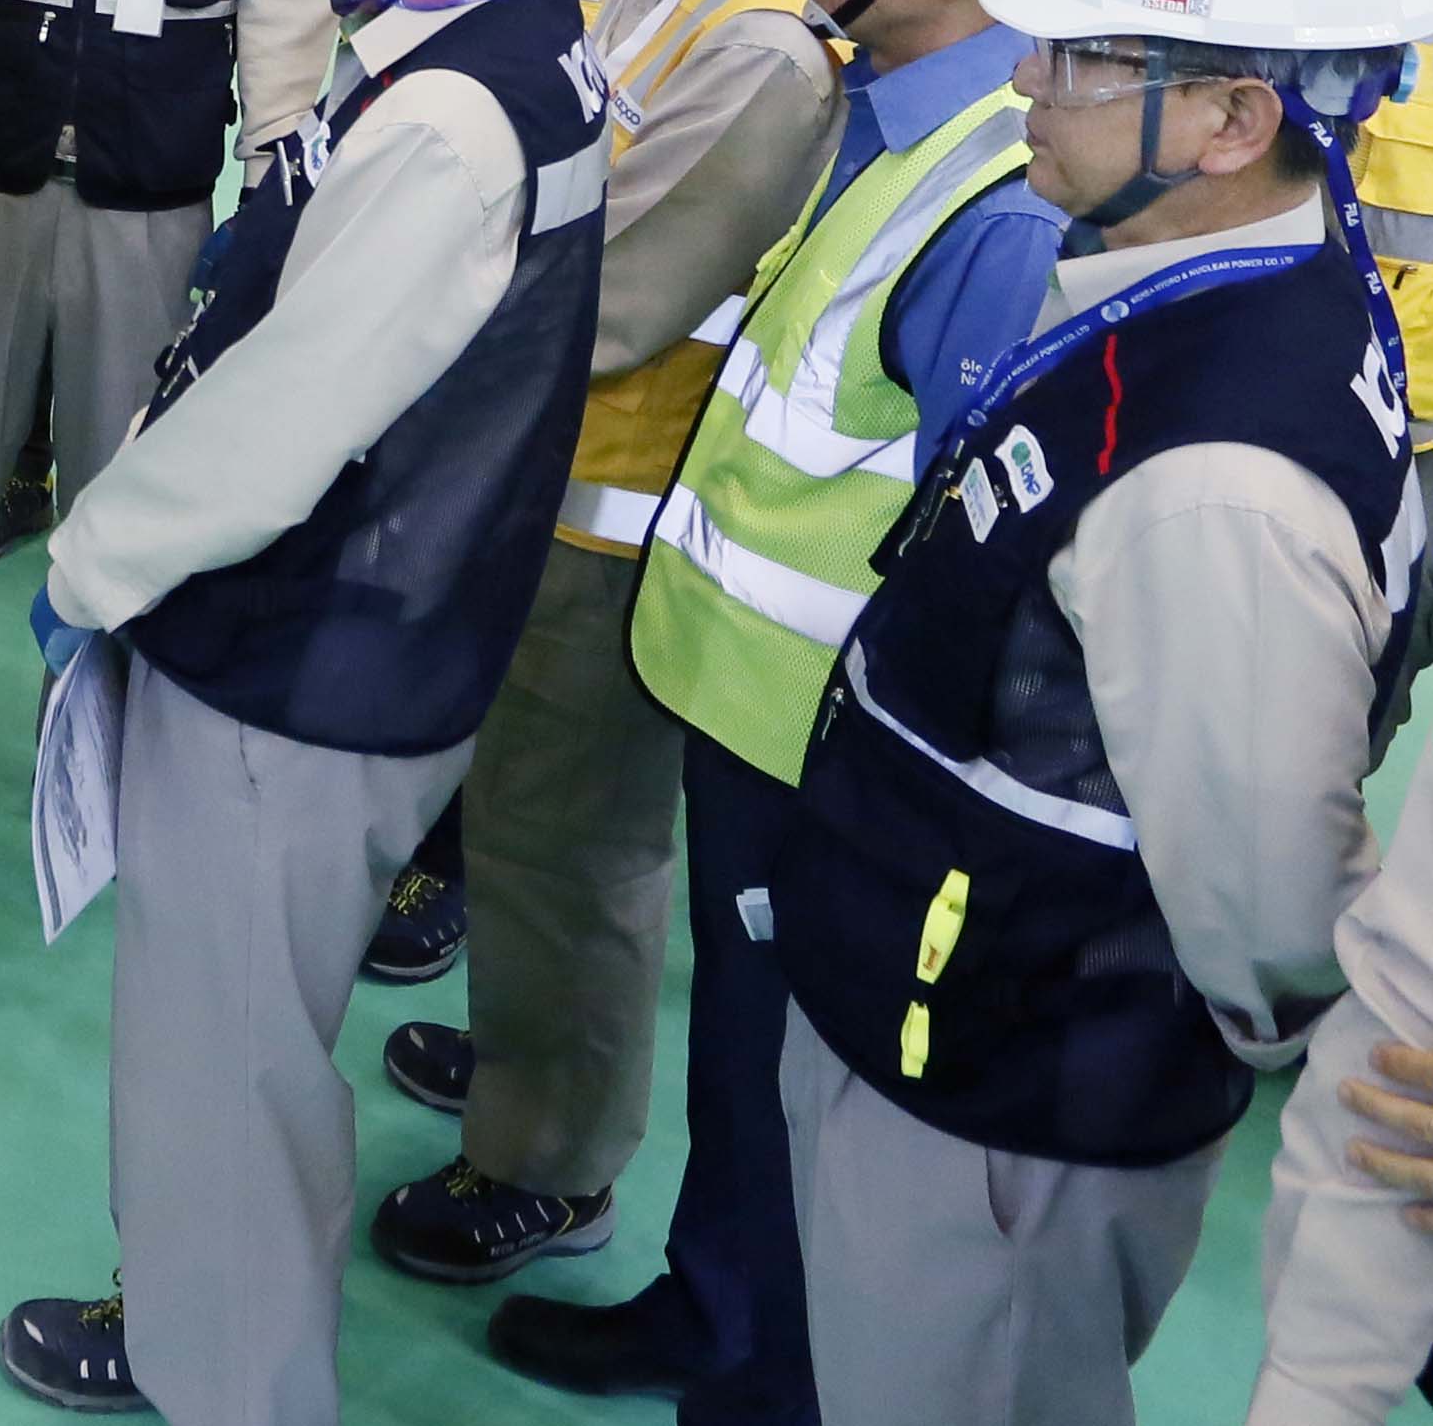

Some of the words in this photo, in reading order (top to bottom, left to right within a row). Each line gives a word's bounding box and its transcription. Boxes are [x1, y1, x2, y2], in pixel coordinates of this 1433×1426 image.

[1308, 120, 1333, 149] FILA
[1343, 202, 1360, 229] FILA
[1154, 276, 1181, 292] HYDRO
[1181, 272, 1189, 281] &
[1188, 263, 1231, 278] NUCLEAR
[1232, 259, 1264, 269] POWER
[1365, 270, 1381, 296] FILA
[1039, 341, 1064, 358] POWER
